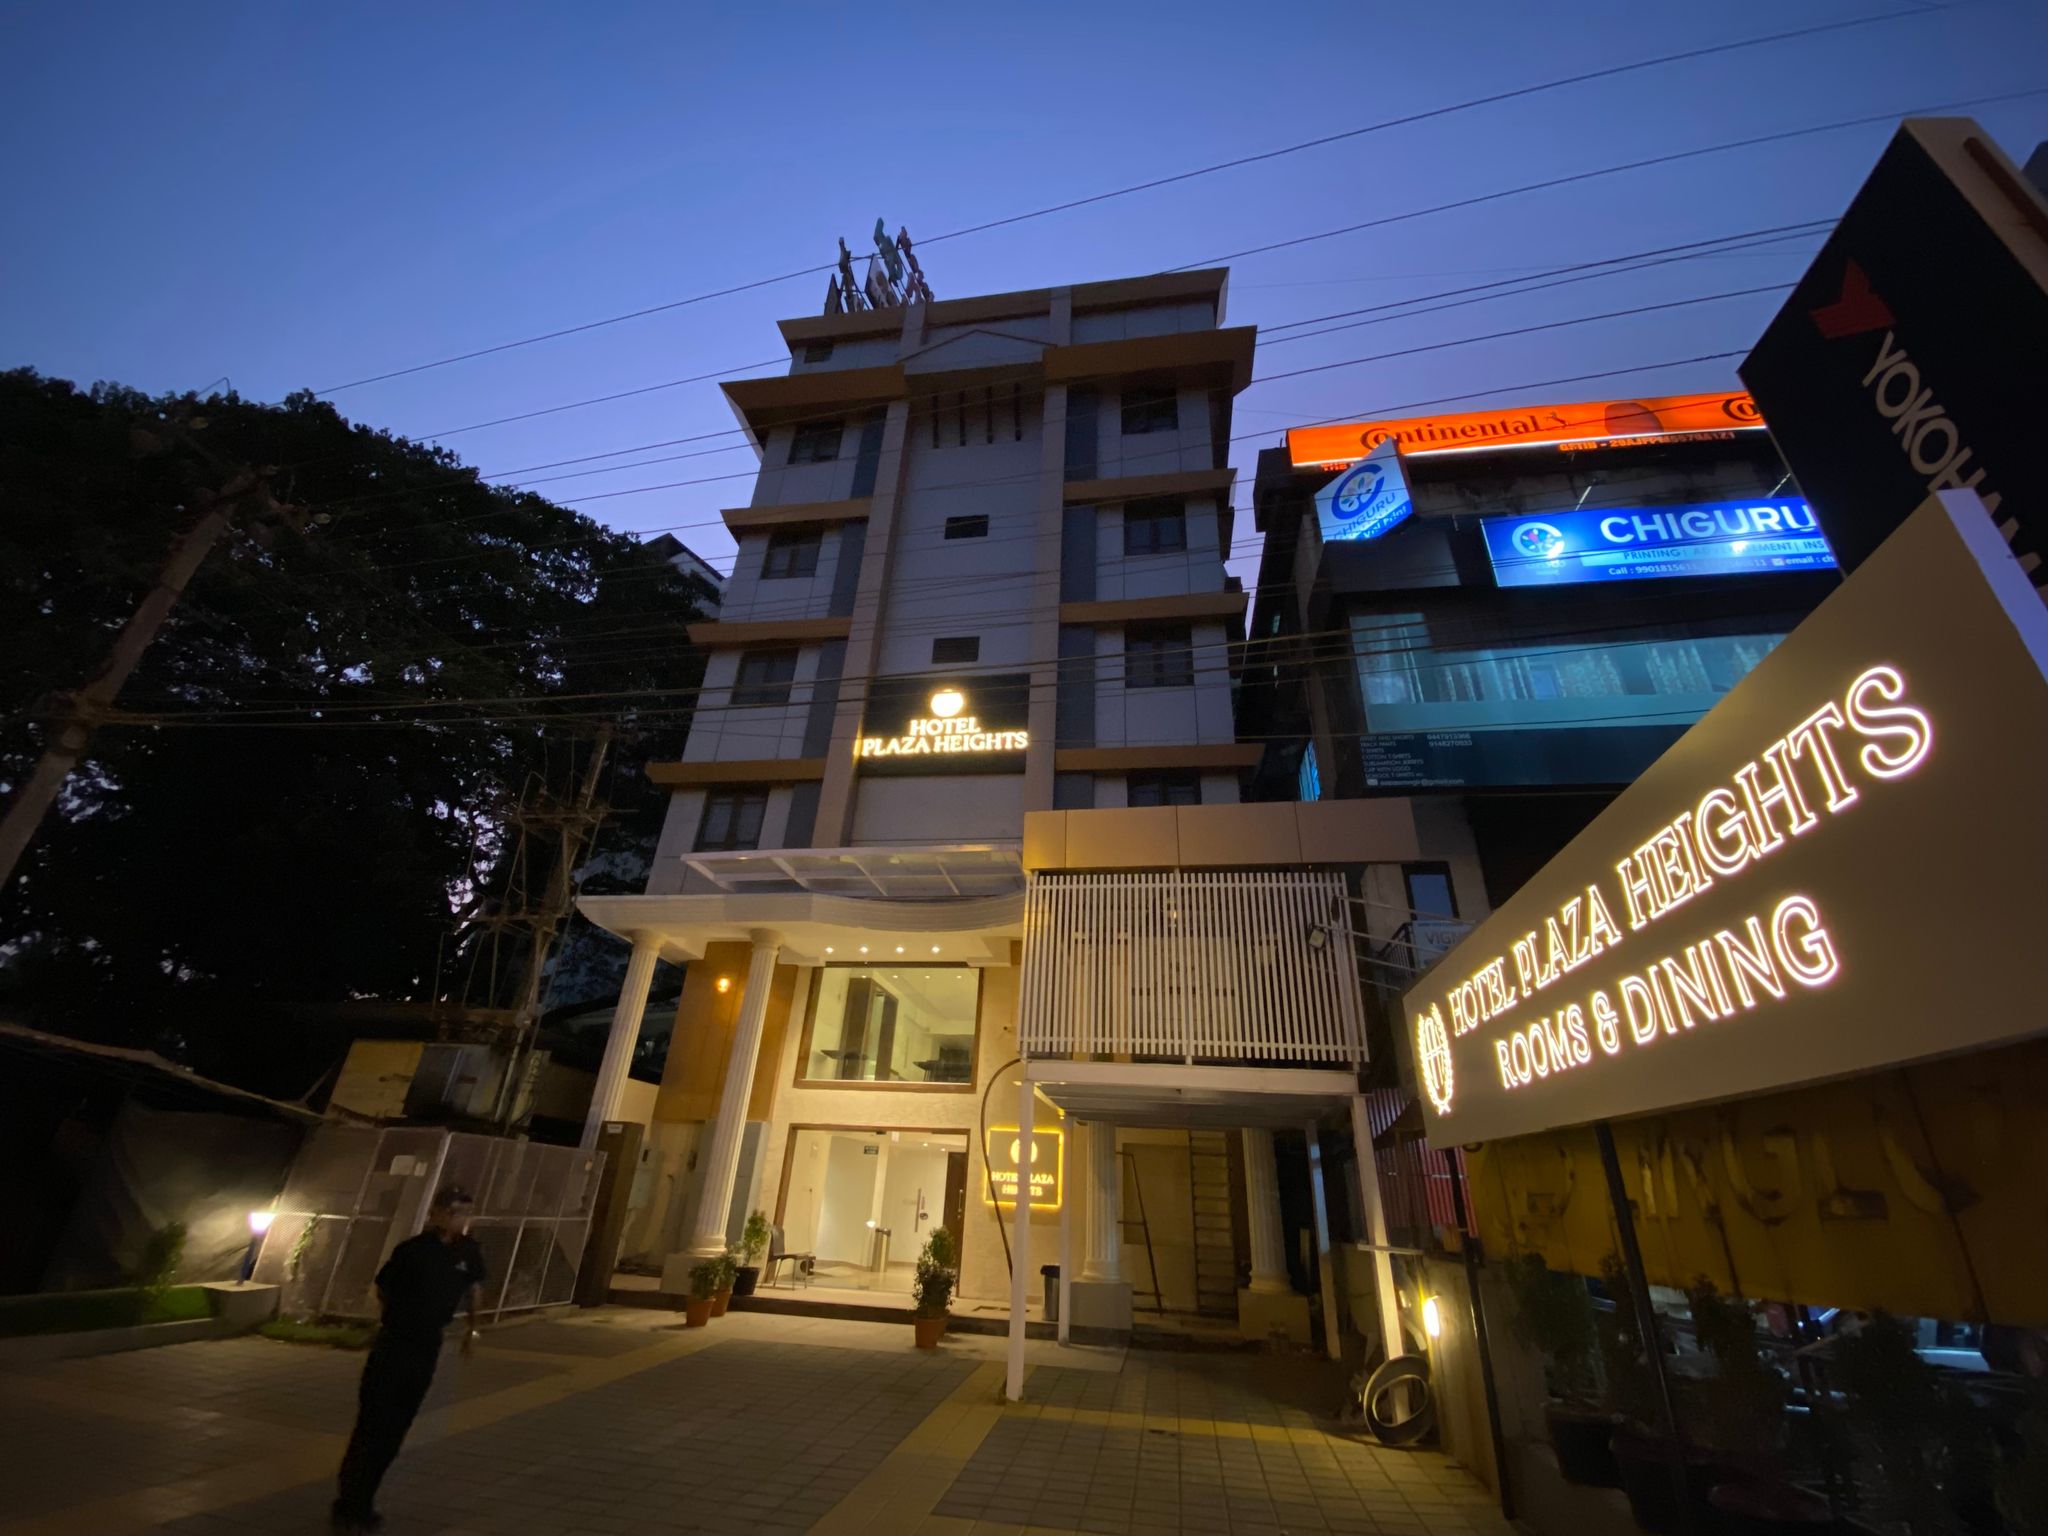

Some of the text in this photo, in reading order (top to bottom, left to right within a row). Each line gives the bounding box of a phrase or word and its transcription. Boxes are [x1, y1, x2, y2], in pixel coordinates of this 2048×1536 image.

[1600, 505, 1817, 543] CHIGURU
[1622, 547, 1681, 561] PRINTING
[1785, 555, 1814, 565] email
[1608, 567, 1628, 576] Call
[910, 717, 982, 736] HOTEL
[861, 731, 1029, 757] PLAZA HEIGHTS
[1448, 666, 1933, 1038] HOTEL PLAZA HEIGHTS
[1496, 895, 1840, 1089] ROOMS & DINING
